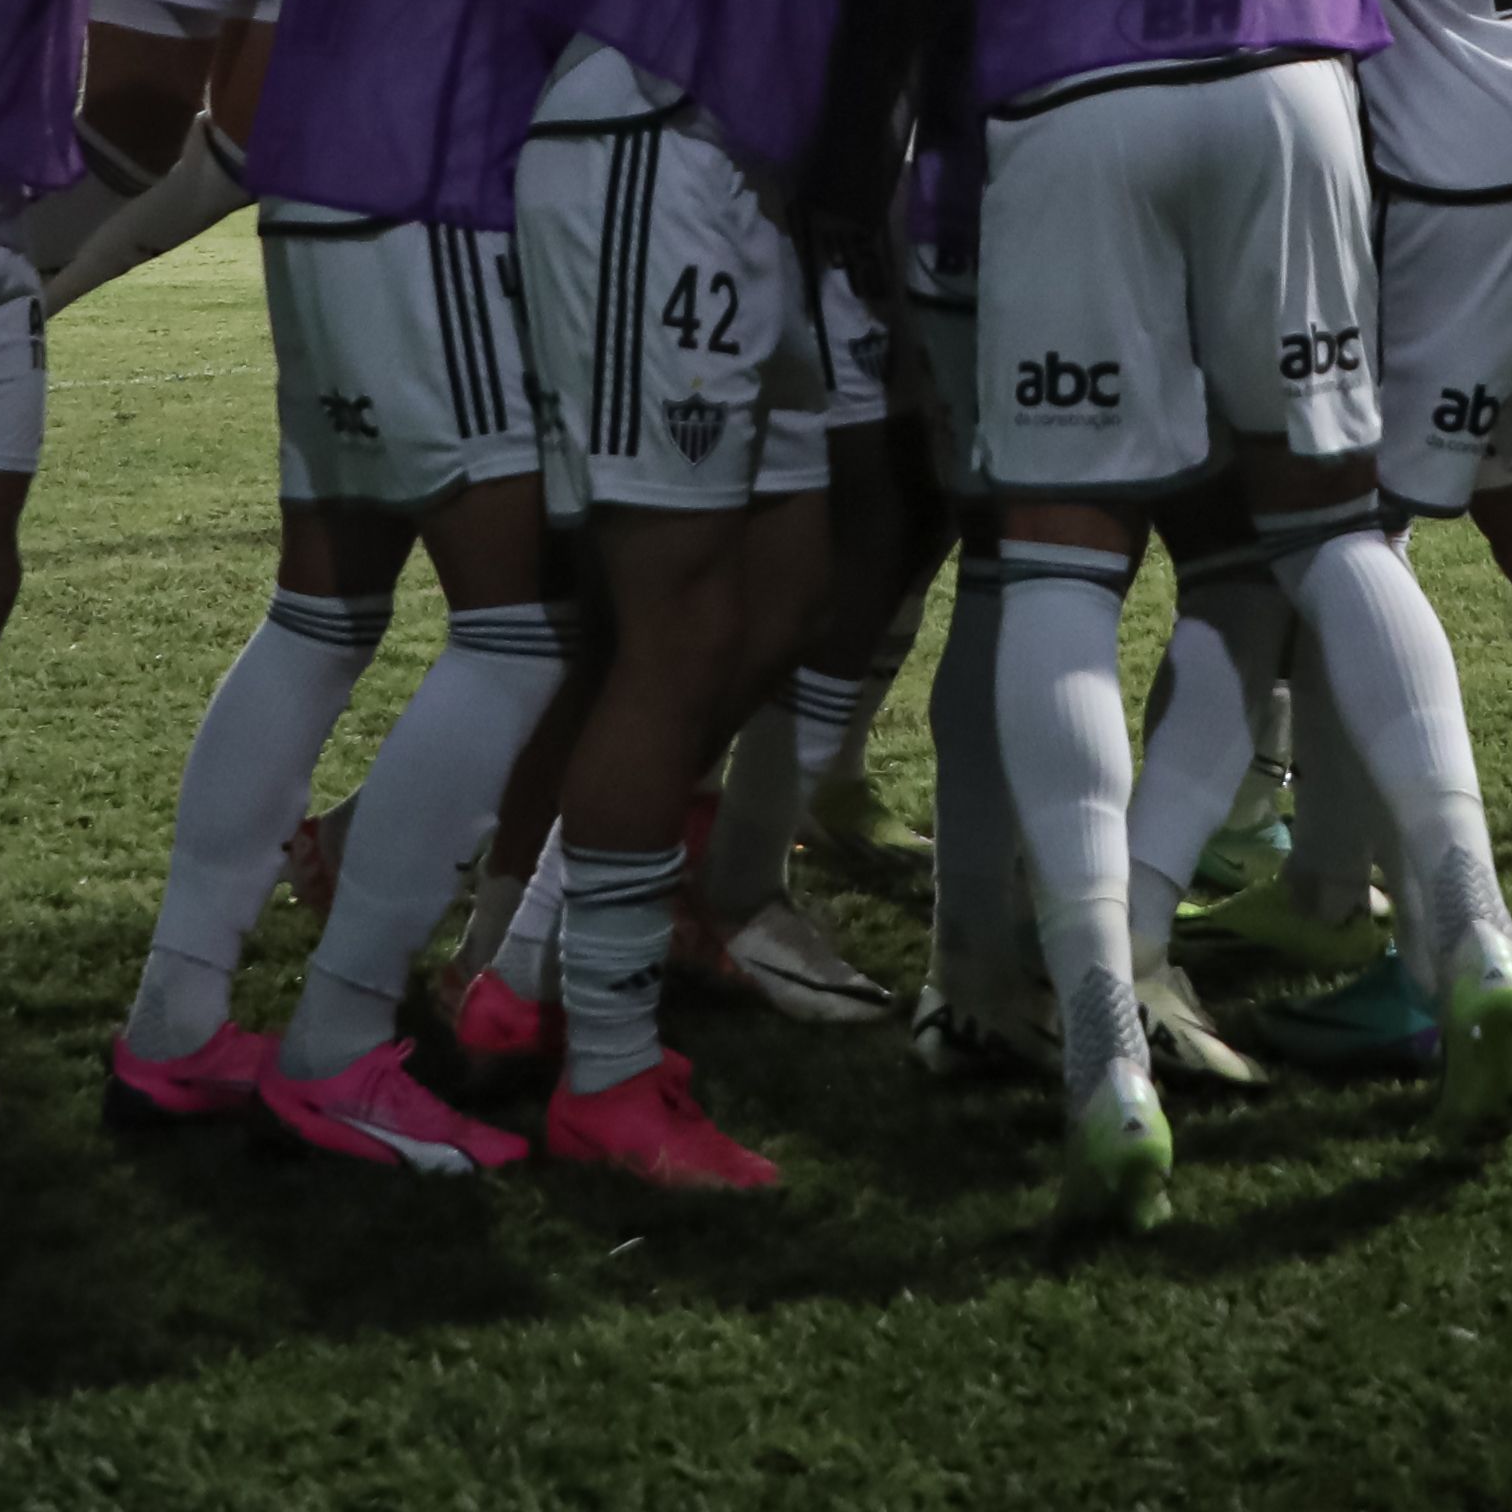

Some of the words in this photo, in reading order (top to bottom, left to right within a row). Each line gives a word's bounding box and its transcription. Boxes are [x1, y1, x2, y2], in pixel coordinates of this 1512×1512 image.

[662, 265, 740, 355] 42
[1279, 322, 1360, 379] abc
[1016, 351, 1120, 407] abc
[1433, 384, 1500, 436] ab
